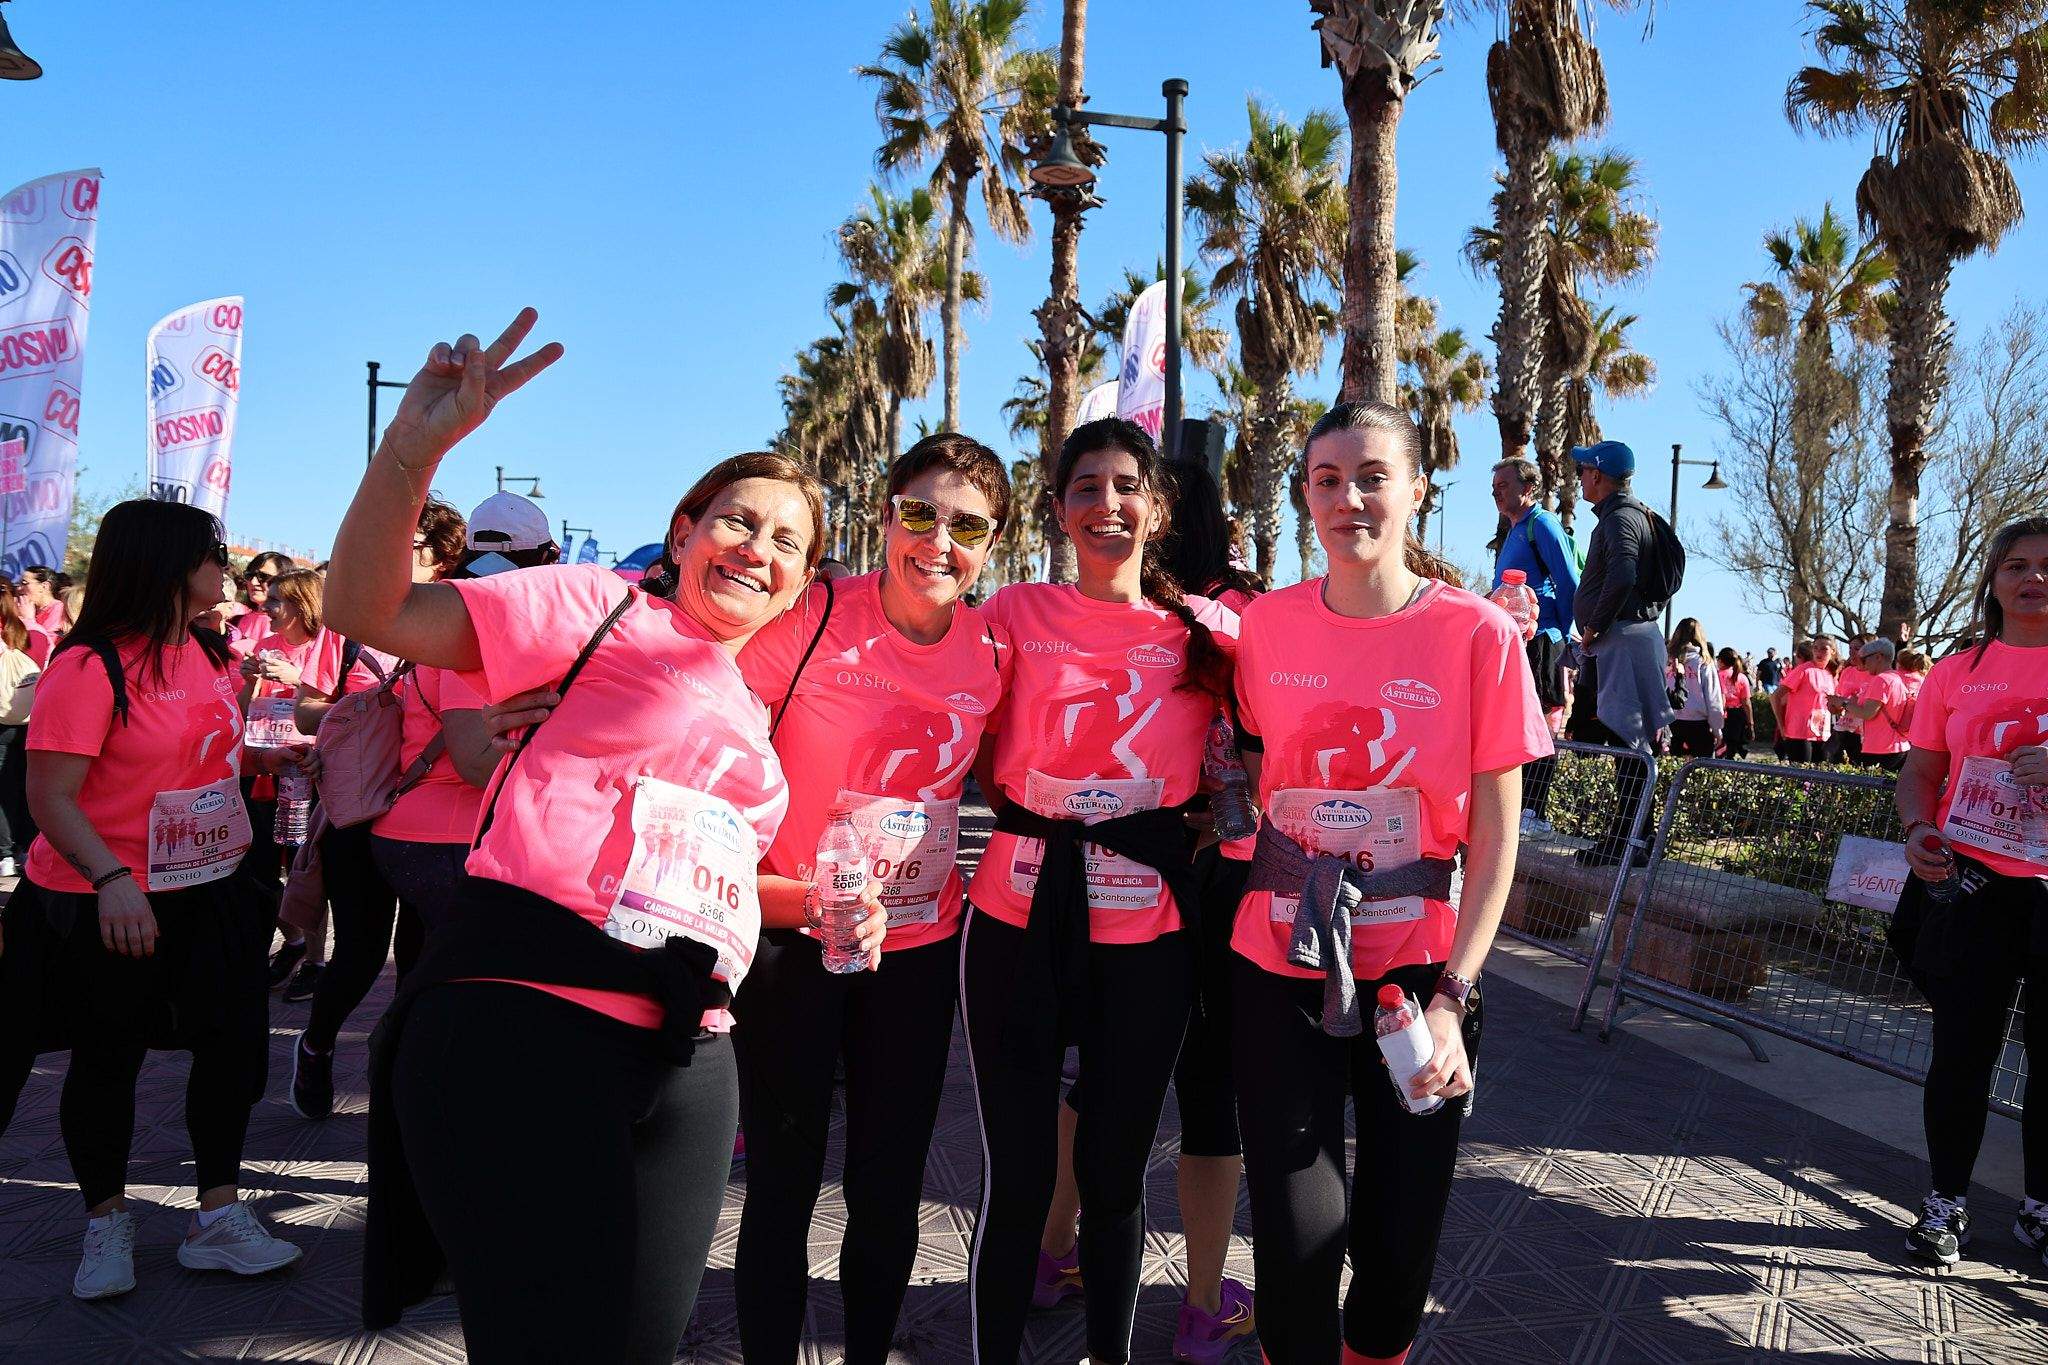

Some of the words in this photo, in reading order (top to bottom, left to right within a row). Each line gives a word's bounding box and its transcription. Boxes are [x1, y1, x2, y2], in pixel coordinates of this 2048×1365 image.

[157, 411, 223, 448] COSMO
[1270, 671, 1328, 689] OYSHO
[1961, 682, 2008, 694] OYSHO
[145, 689, 186, 702] OSHO
[1386, 686, 1436, 705] ASTURIANA
[1067, 798, 1118, 811] ASTURIANA
[1315, 809, 1367, 822] ASTURIANA
[1994, 820, 2016, 832] 6912
[194, 825, 229, 847] 016
[1956, 829, 1989, 844] OYSHO
[873, 859, 922, 881] 016
[163, 872, 201, 884] OYSHO
[833, 872, 863, 882] ZERO
[1111, 876, 1143, 885] VALENCIA
[693, 865, 739, 909] 016
[833, 880, 863, 889] SODIO
[882, 886, 901, 896] 368
[1100, 892, 1146, 904] Santander
[643, 900, 682, 921] CARRERA
[699, 902, 725, 923] 5366
[1361, 905, 1407, 917] Santander
